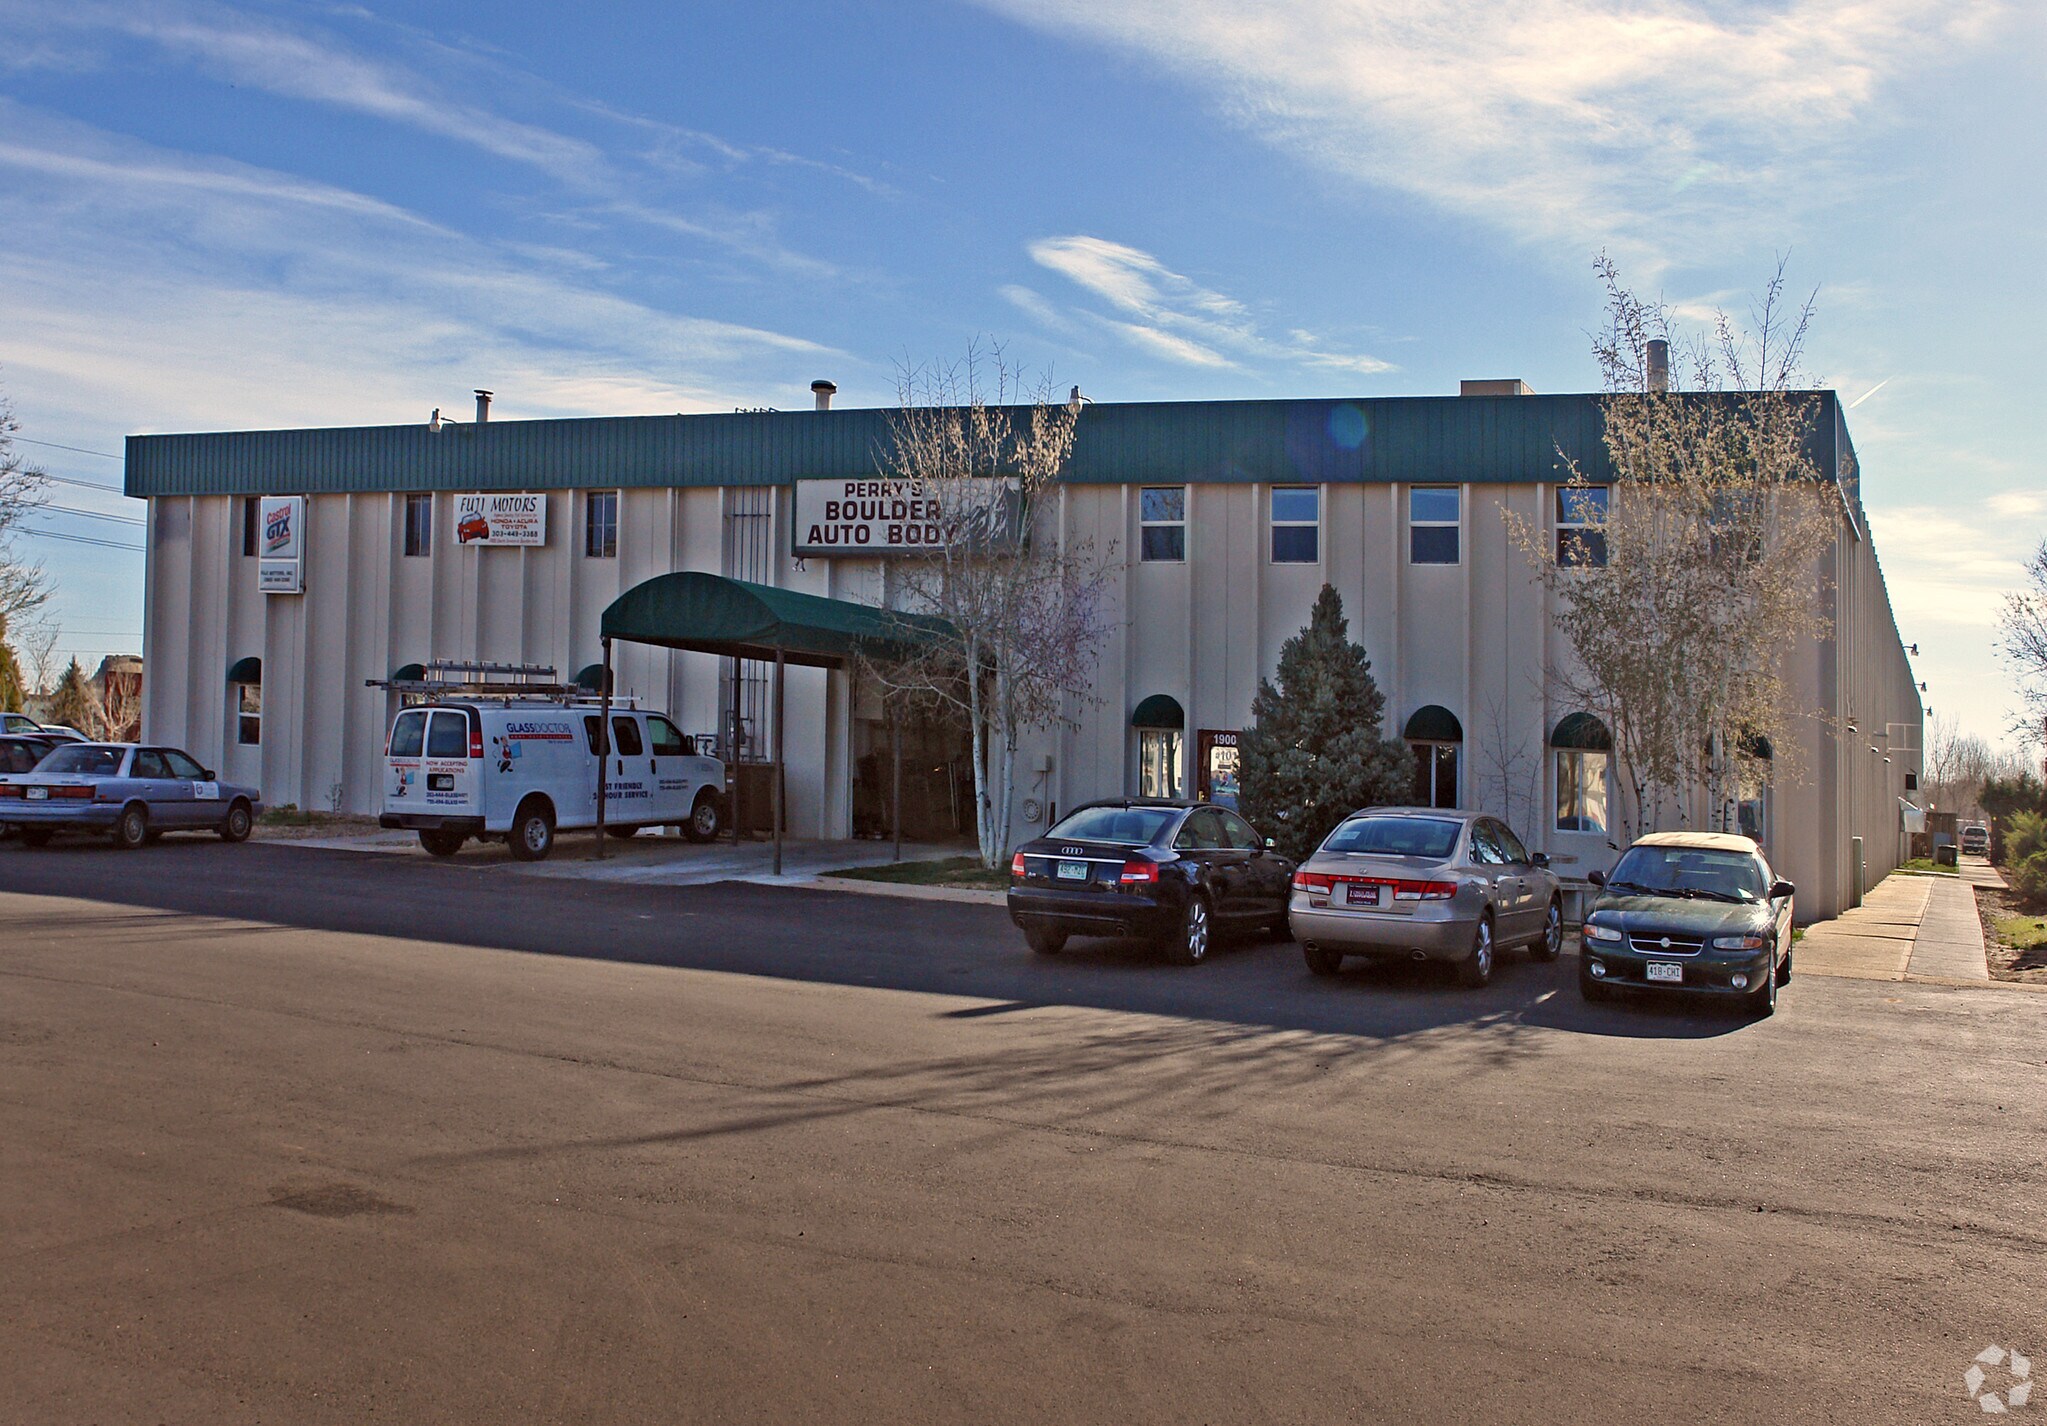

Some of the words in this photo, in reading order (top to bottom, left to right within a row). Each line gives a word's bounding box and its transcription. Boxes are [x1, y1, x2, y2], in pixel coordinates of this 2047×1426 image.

[844, 482, 923, 497] PERRY'S
[460, 497, 485, 512] FUJI
[491, 497, 537, 512] MOTORS
[825, 500, 942, 520] BOULDER
[266, 503, 291, 525] Castrol
[266, 516, 290, 540] GTX
[807, 524, 871, 544] AUTO
[888, 524, 958, 544] BODY
[1213, 733, 1237, 745] 1900
[615, 782, 642, 790] FRIENDLY
